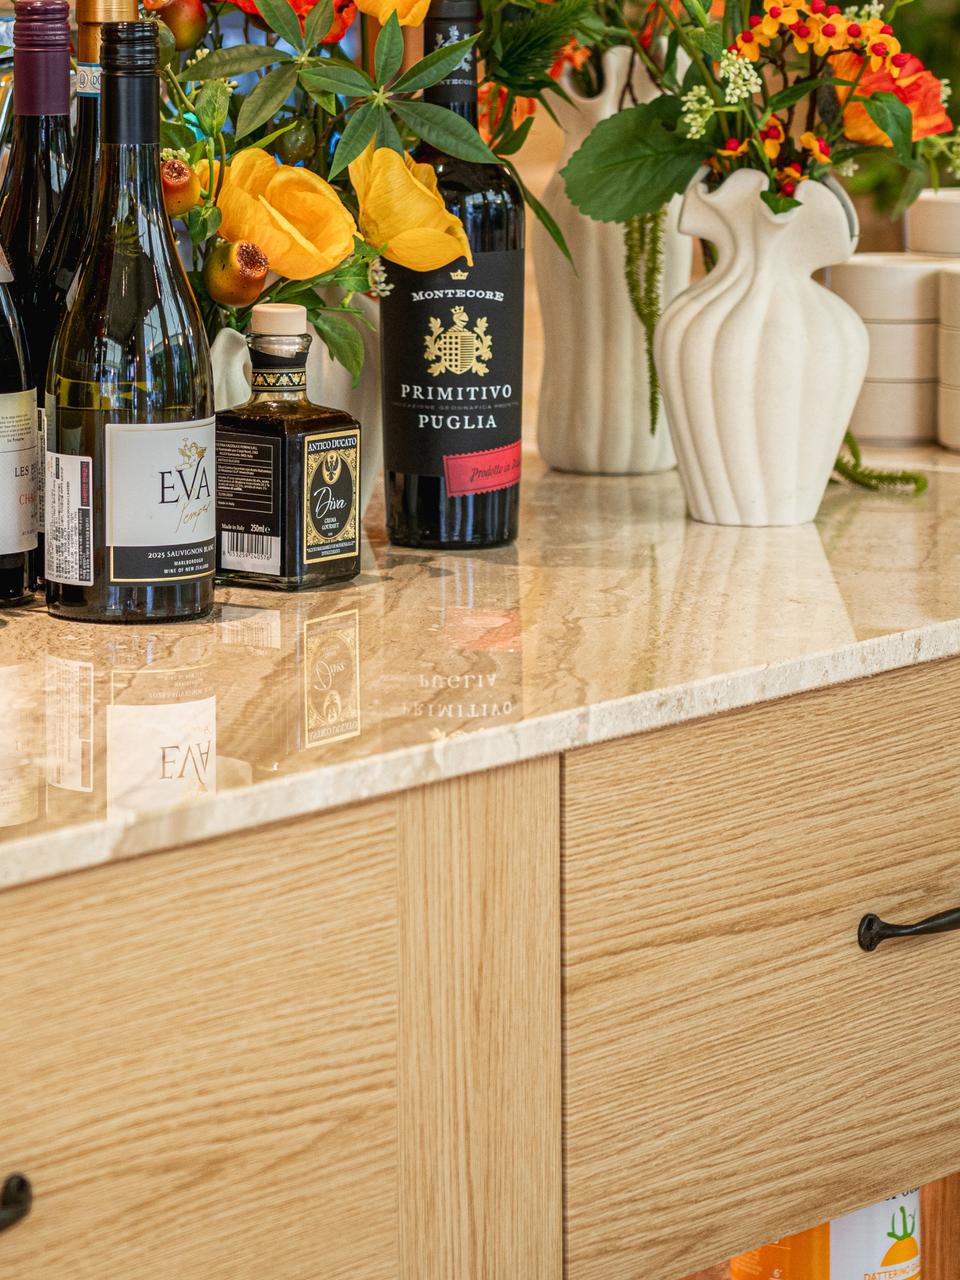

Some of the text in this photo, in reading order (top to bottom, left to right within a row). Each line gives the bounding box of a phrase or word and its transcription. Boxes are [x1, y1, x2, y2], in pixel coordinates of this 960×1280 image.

[411, 289, 505, 302] MONTECORE
[400, 384, 512, 401] PRIMITIVO
[418, 415, 498, 430] PUGLIA
[307, 437, 357, 452] ANTICO DUCATO
[14, 465, 29, 478] LES
[158, 457, 211, 505] EVA
[313, 486, 347, 519] Diva
[166, 547, 203, 558] SAUVIGNON
